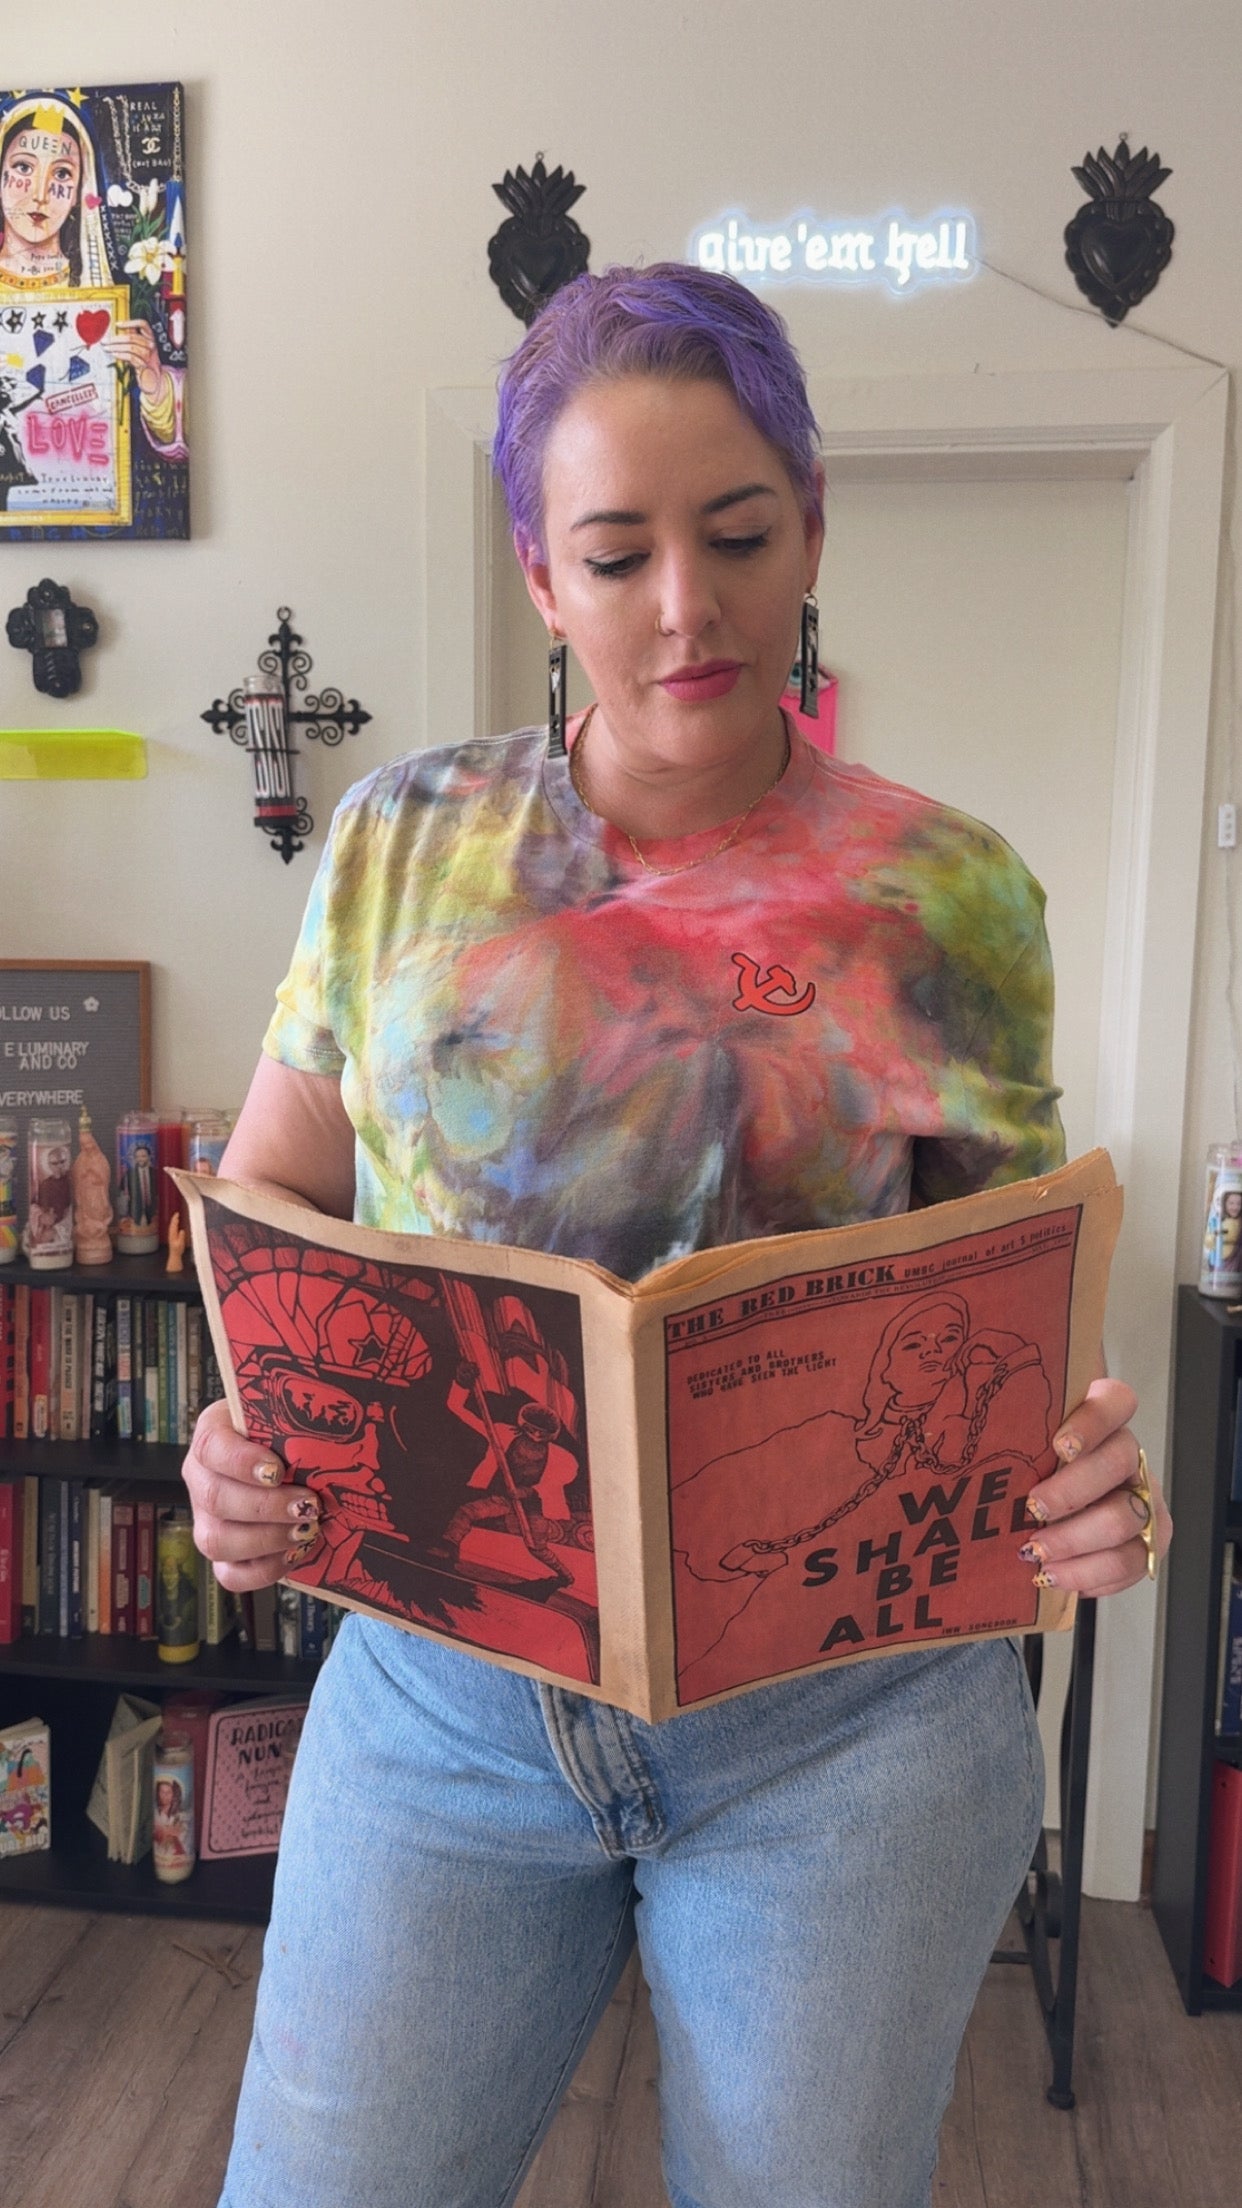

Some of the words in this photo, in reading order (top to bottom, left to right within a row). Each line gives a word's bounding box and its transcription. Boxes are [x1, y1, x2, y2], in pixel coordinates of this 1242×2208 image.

[130, 101, 157, 111] REAL
[19, 136, 72, 155] QUEEN
[9, 175, 32, 192] POP
[48, 182, 74, 200] ART
[797, 222, 875, 271] 'em
[884, 221, 970, 285] hell
[26, 413, 109, 466] LOVE
[0, 1005, 42, 1021] LLOW
[49, 1005, 71, 1021] US
[4, 1041, 15, 1057] E
[18, 1041, 89, 1057] LUMINARY
[19, 1055, 52, 1070] AND
[57, 1055, 77, 1070] CO
[668, 1307, 725, 1339] THE
[740, 1282, 796, 1318] RED
[805, 1263, 897, 1298] BRICK
[941, 1250, 978, 1270] journal
[985, 1245, 996, 1258] of
[1001, 1240, 1015, 1253] art
[1029, 1224, 1067, 1243] politics
[687, 1359, 743, 1386] DEDICATED
[748, 1353, 760, 1365] TO
[766, 1349, 785, 1360] ALL
[689, 1373, 735, 1394] SISTERS
[741, 1364, 762, 1376] AND
[769, 1351, 825, 1370] BROTHERS
[692, 1388, 714, 1399] WHO
[720, 1378, 743, 1393] HAVE
[751, 1371, 776, 1384] SEEN
[782, 1365, 799, 1377] THE
[806, 1357, 837, 1373] LIGHT
[898, 1466, 1012, 1526] WE
[802, 1495, 1047, 1588] SHALL
[875, 1548, 960, 1601] BE
[819, 1594, 944, 1652] ALL
[239, 1741, 280, 1765] NUN
